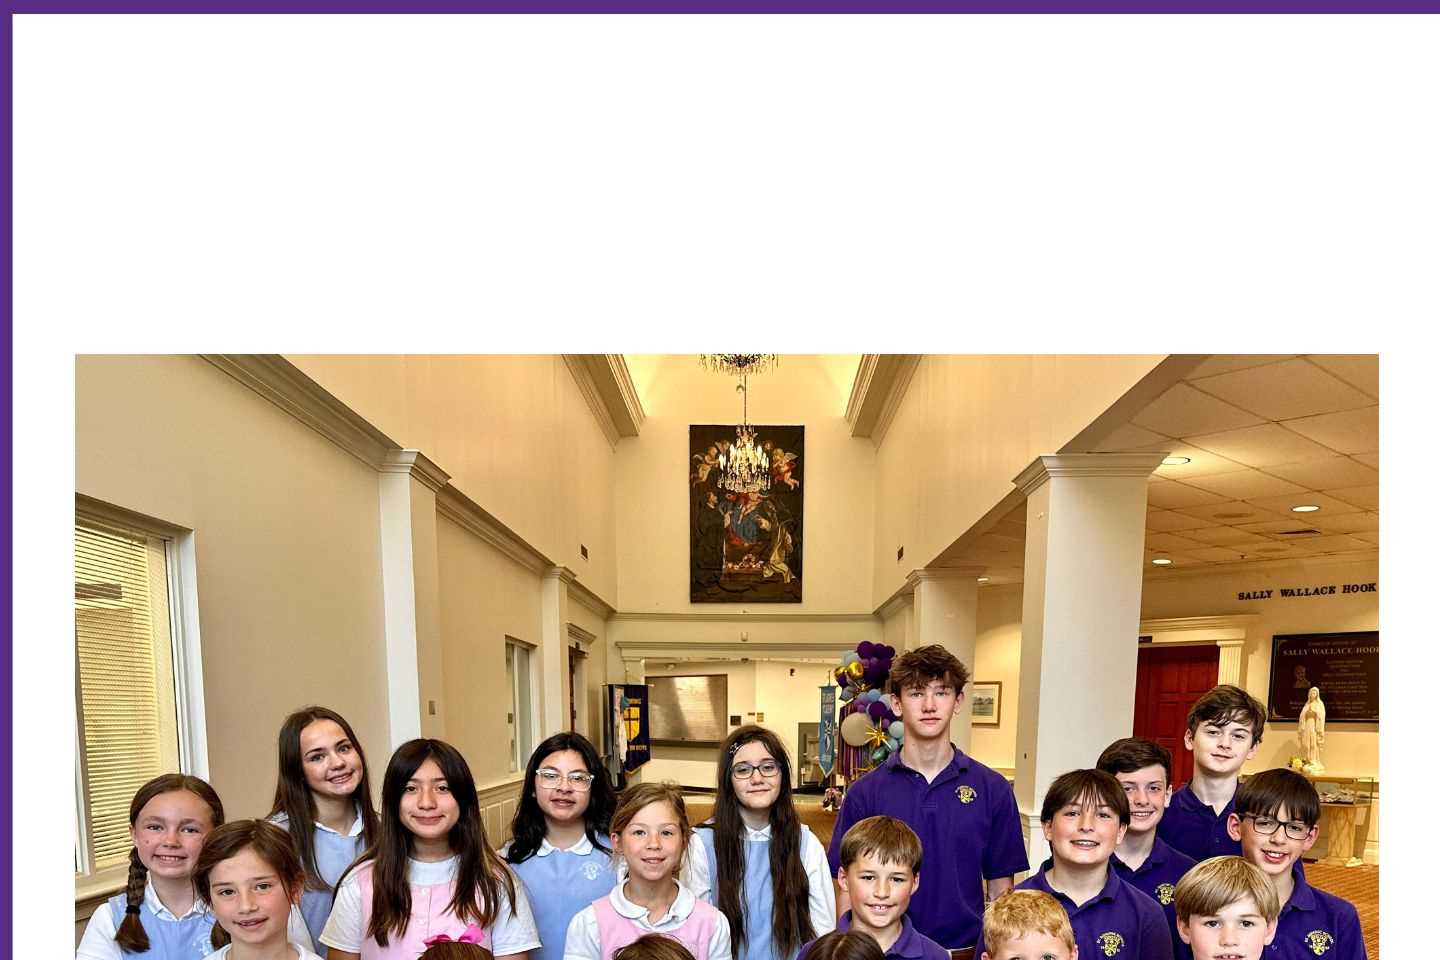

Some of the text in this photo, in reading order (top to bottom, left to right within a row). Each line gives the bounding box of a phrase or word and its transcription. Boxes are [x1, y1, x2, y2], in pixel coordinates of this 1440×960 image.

[1238, 583, 1376, 600] SALLY WALLACE HOOK
